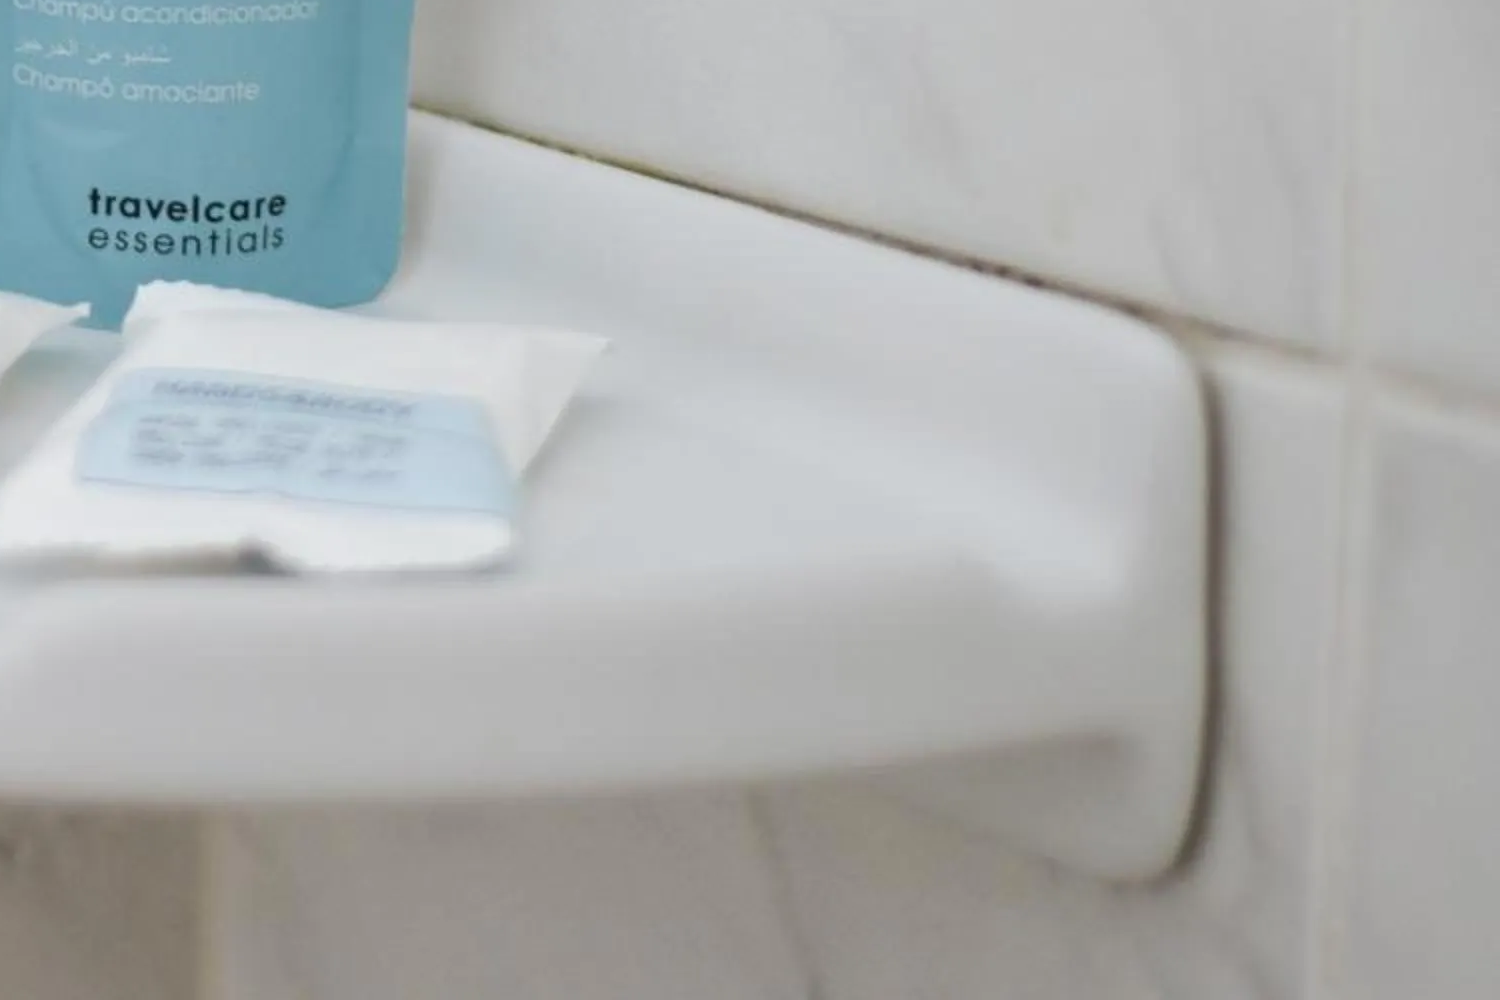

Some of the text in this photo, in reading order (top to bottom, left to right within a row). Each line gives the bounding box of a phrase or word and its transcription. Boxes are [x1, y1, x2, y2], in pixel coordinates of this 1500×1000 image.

[121, 79, 261, 105] amaciante
[87, 187, 287, 224] travelcare
[87, 224, 286, 258] essentials
